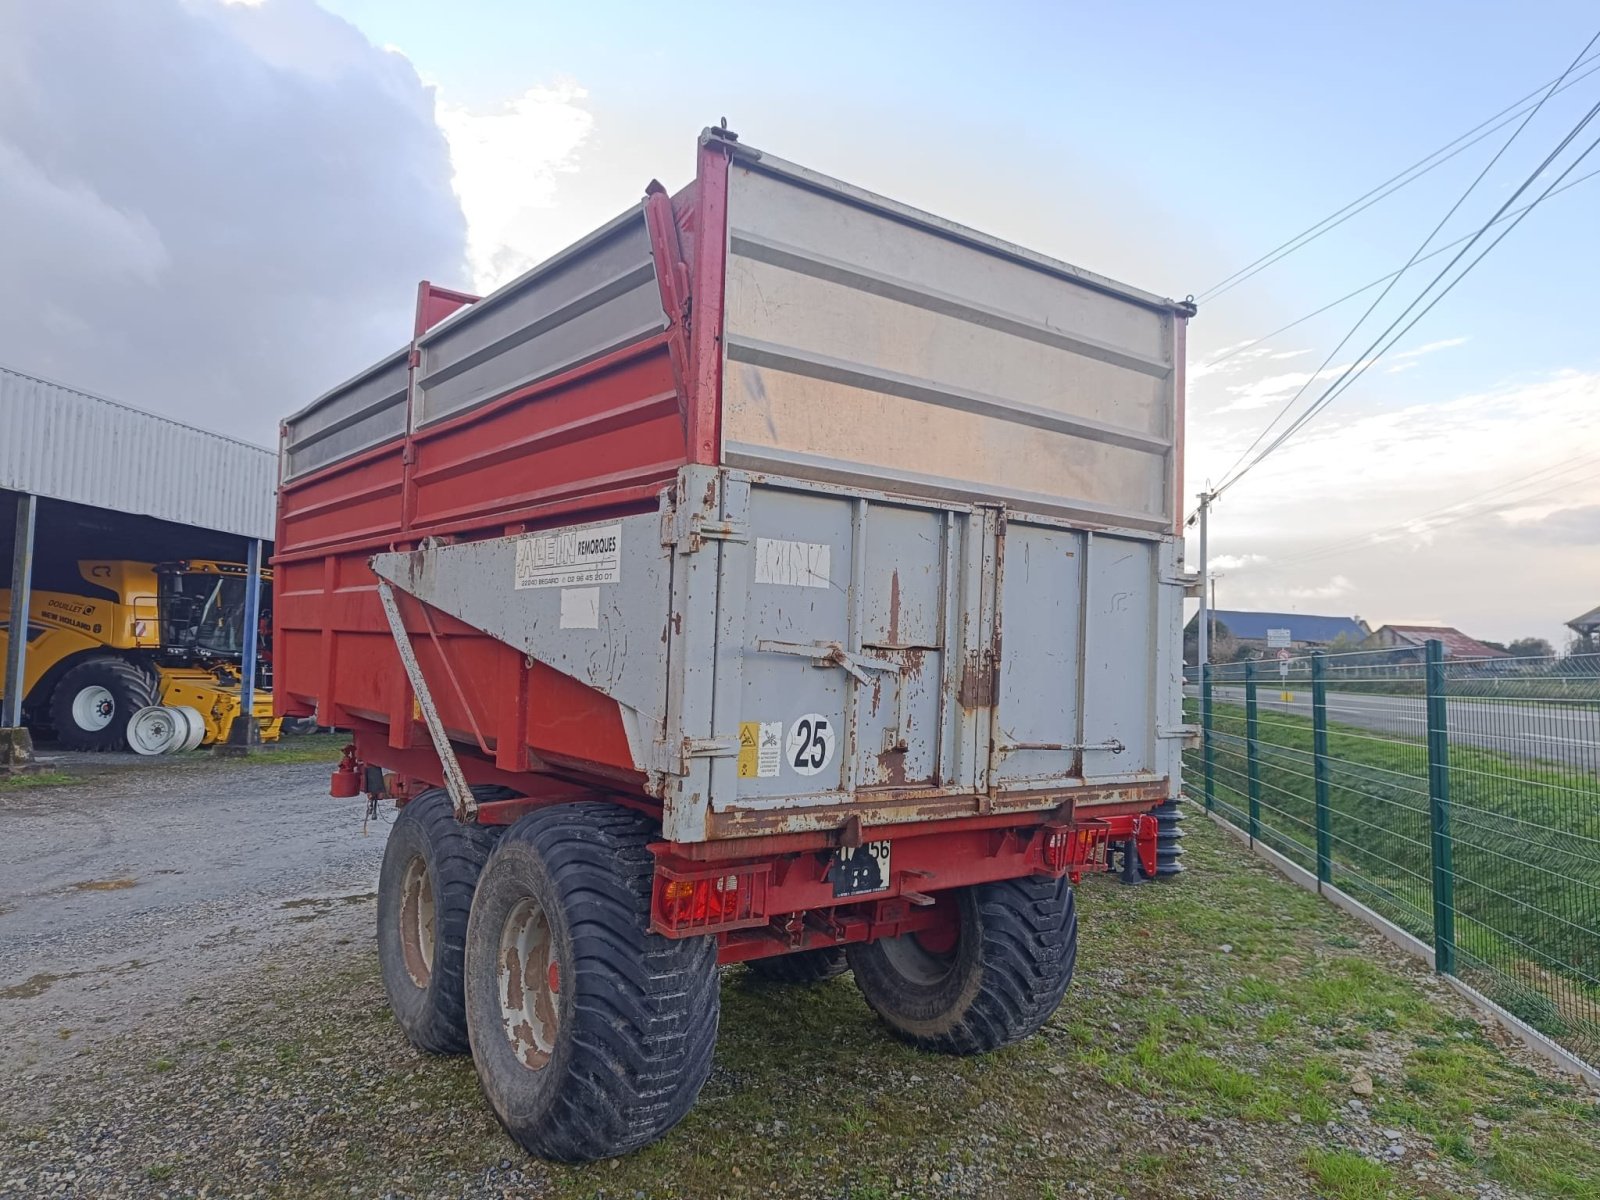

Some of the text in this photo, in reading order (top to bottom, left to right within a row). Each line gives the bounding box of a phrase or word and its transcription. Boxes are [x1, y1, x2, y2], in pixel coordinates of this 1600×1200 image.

[577, 537, 616, 556] REMORQUES
[48, 600, 82, 613] DOUILLET
[41, 611, 91, 631] NEW HOLLAND
[794, 719, 827, 768] 25
